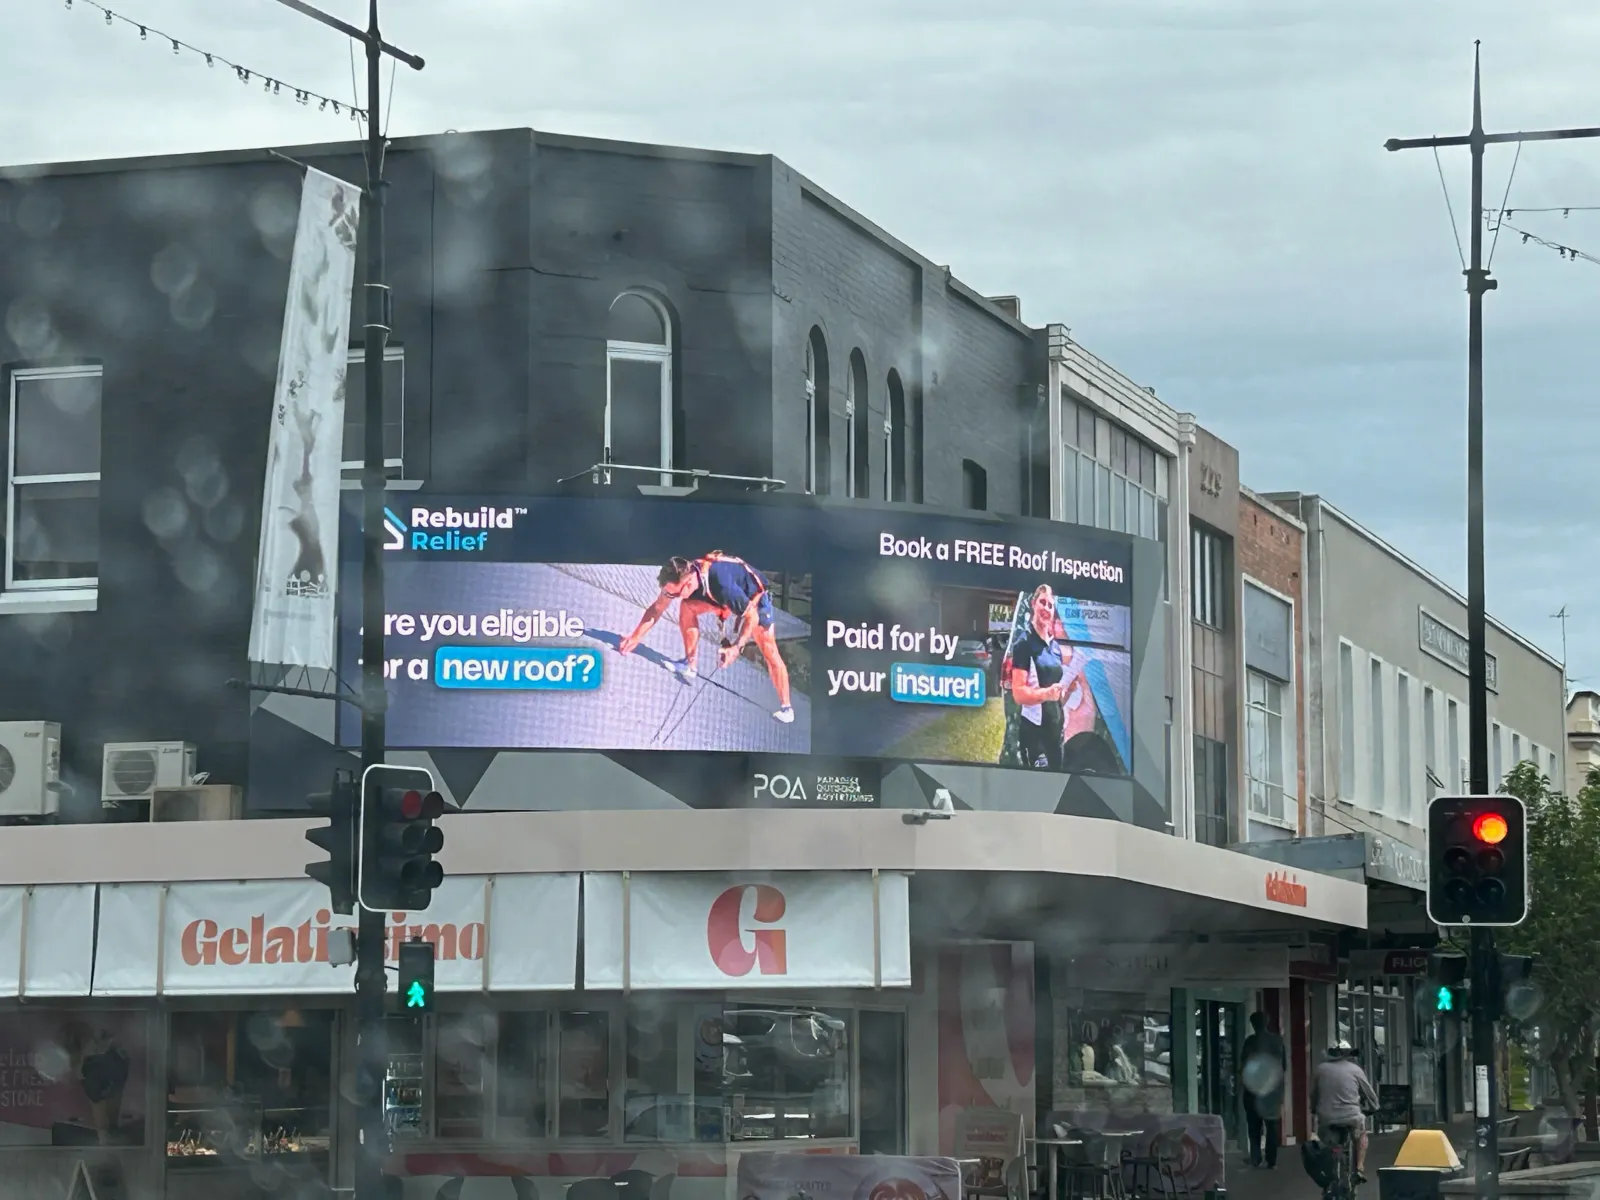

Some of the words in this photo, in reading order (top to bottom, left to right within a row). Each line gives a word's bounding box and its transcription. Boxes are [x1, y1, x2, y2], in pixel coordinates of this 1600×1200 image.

[411, 530, 488, 551] Relief
[879, 532, 932, 559] Book
[936, 543, 949, 560] a
[954, 539, 1005, 566] FREE
[1009, 546, 1048, 571] Roof
[1051, 551, 1124, 583] Inspection
[359, 613, 416, 636] re
[420, 613, 477, 641] you
[481, 608, 585, 642] eligible
[826, 620, 884, 650] Paid
[889, 624, 925, 653] for
[929, 627, 959, 660] by
[407, 658, 429, 680] a
[442, 658, 508, 681] new
[513, 654, 595, 682] roof?
[827, 669, 886, 696] your
[896, 666, 980, 699] insurer!
[753, 774, 807, 800] POA
[181, 908, 485, 966] Gelatiimo
[706, 883, 788, 977] G
